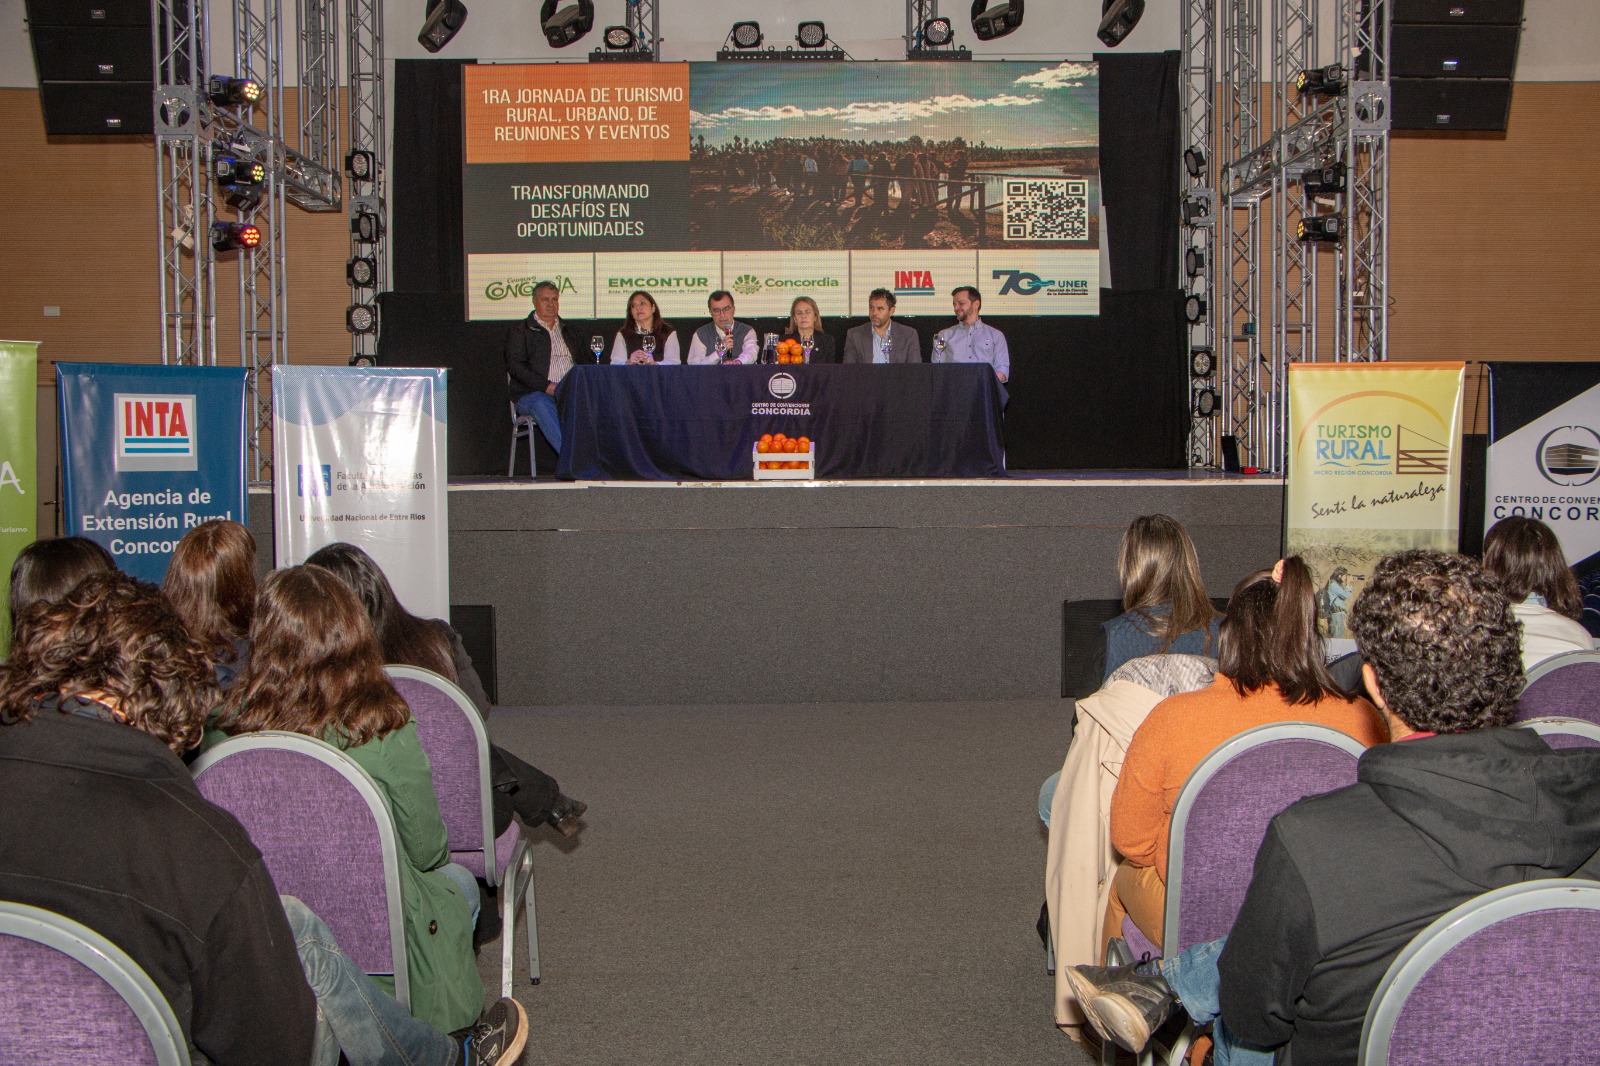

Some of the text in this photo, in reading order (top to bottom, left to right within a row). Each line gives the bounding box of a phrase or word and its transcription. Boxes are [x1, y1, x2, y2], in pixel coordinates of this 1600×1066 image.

[482, 87, 683, 104] 1RA JORNADA DE TURISMO
[506, 106, 658, 123] RURAL, URBANO, DE
[495, 124, 671, 141] REUNIONES Y EVENTOS
[511, 184, 650, 200] TRANSFORMANDO
[531, 200, 630, 219] DESAFÍOS EN
[516, 221, 644, 238] OPORTUNIDADES
[608, 277, 708, 288] EMCONTUR
[764, 277, 839, 288] Concordia
[895, 271, 934, 288] INTA
[1058, 280, 1088, 288] UNER
[124, 401, 188, 437] INTA
[751, 408, 811, 416] CONCORDIA
[1317, 424, 1392, 439] TURISMO
[1316, 439, 1392, 460] RURAL
[103, 487, 211, 510] Agencia de
[1351, 494, 1366, 509] la
[1370, 481, 1446, 507] naturaleza
[1495, 495, 1540, 504] CENTRO
[1542, 496, 1557, 504] DE
[82, 512, 178, 532] Extensión
